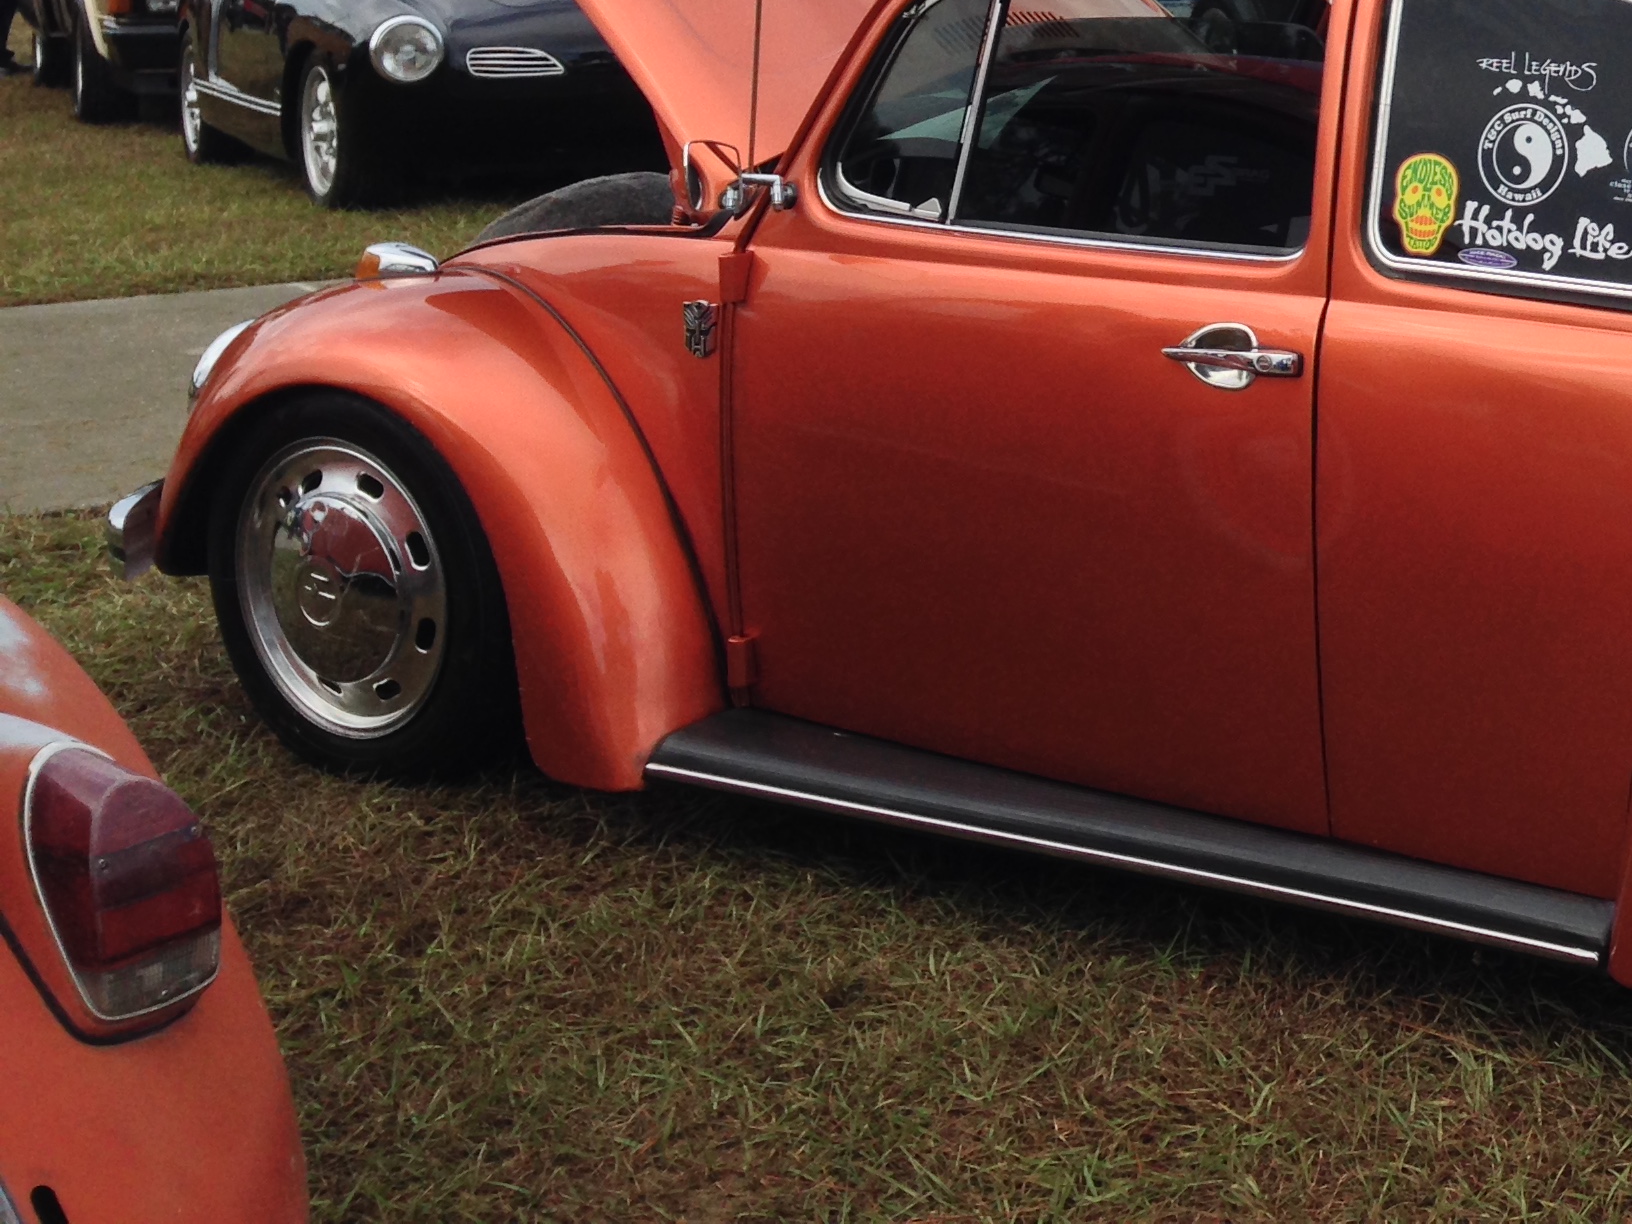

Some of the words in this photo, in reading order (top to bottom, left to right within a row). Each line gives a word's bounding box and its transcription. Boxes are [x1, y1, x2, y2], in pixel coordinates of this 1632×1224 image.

[1476, 51, 1518, 74] REEL
[1484, 121, 1504, 150] T&C
[1503, 108, 1533, 125] Surf
[1534, 110, 1564, 156] Designs
[1497, 183, 1543, 202] Hawaii
[1453, 200, 1564, 271] Hotdog
